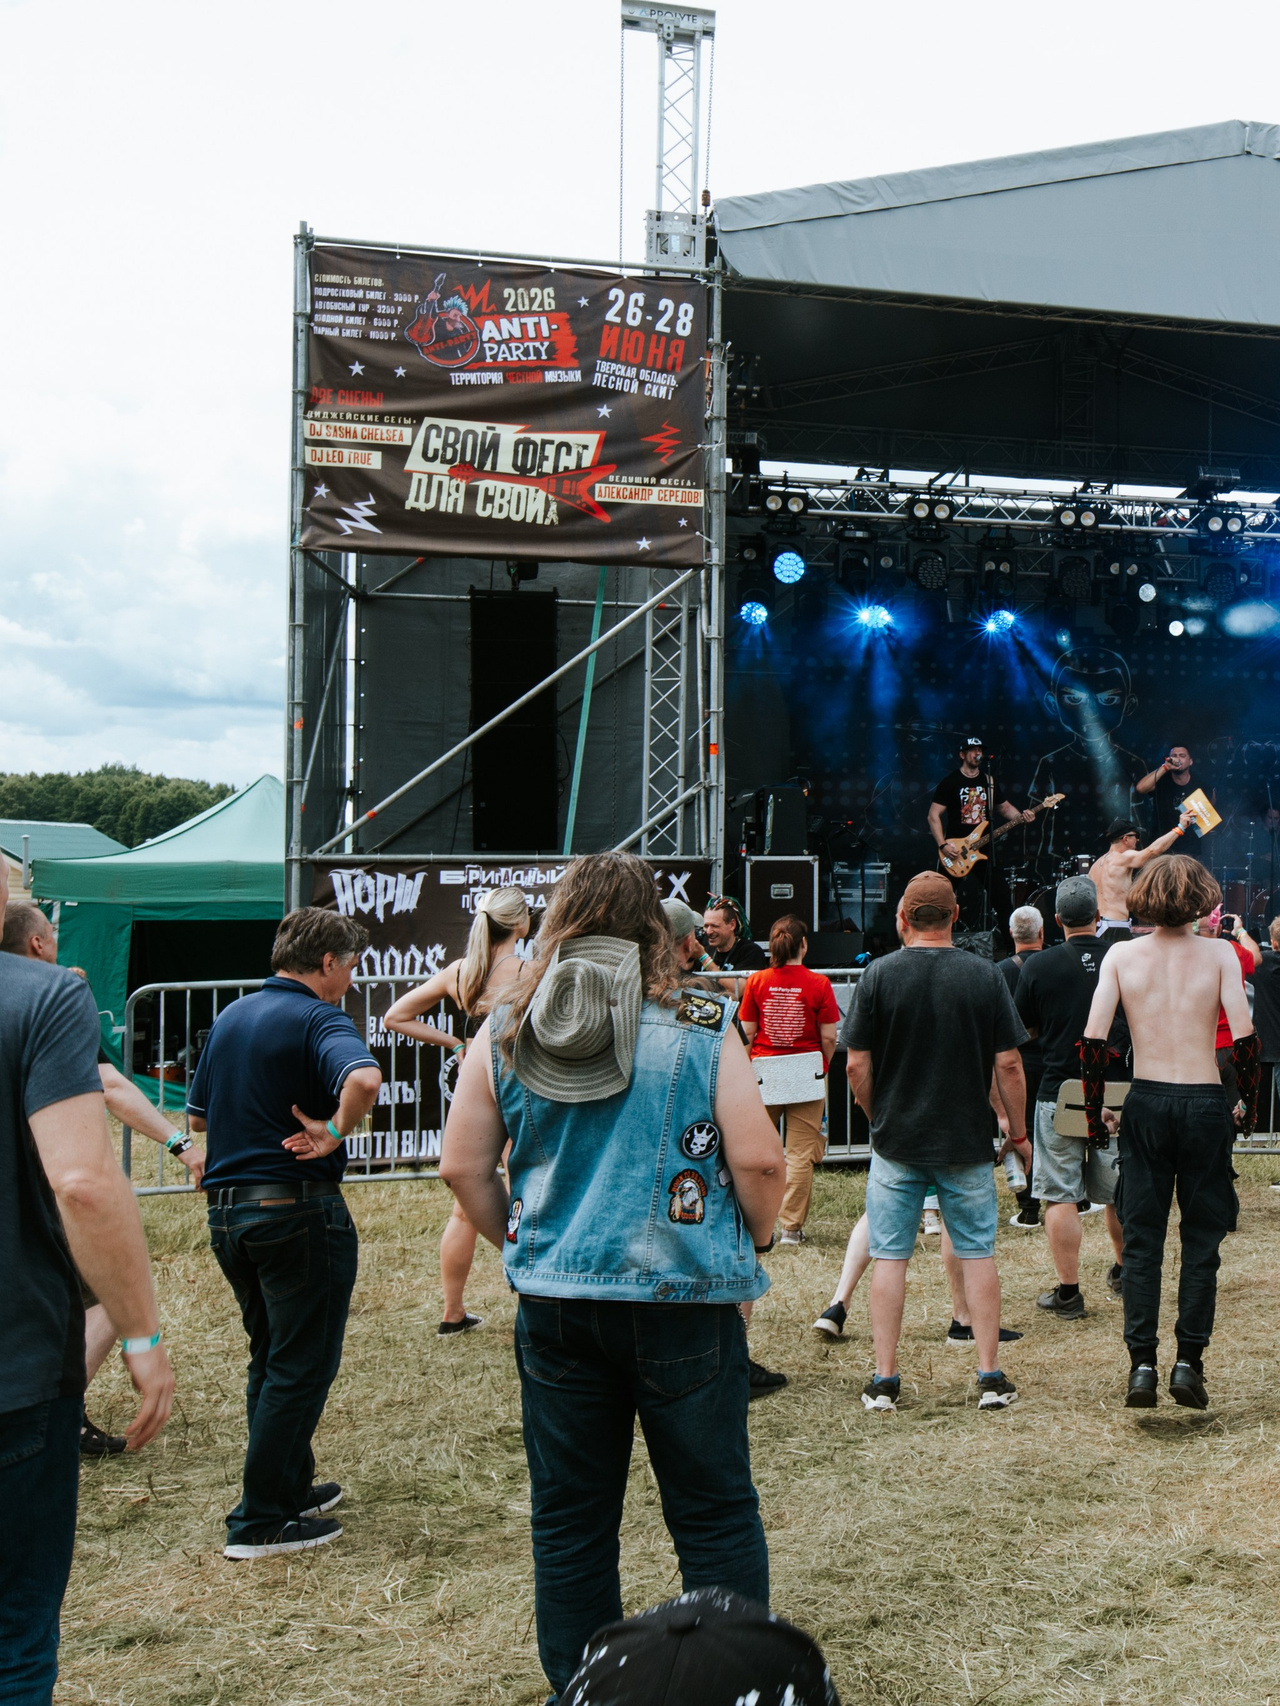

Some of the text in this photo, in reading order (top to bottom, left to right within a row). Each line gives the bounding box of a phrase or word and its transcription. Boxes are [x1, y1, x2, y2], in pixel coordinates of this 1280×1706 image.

[314, 273, 351, 285] СТОИМОСТЬ
[314, 287, 363, 299] ПОДРОСТКОВЫЙ
[365, 290, 387, 300] БИЛЕТ
[503, 287, 555, 312] 2026
[314, 301, 356, 311] АВТОБУСНЫЙ
[605, 287, 694, 337] 26-28
[345, 316, 366, 325] БИЛЕТ
[481, 316, 559, 342] ANTI-
[313, 326, 339, 337] ПАРНЫЙ
[341, 328, 362, 338] БИЛЕТ
[484, 341, 549, 362] PARTY
[599, 324, 685, 373] ИЮНЯ
[450, 370, 582, 385] ТЕРРИТОРИЯ ЧЕСТНОЙ МУЗЫКИ
[596, 360, 637, 379] ТВЕРСКАЯ
[310, 386, 333, 405] ДВЕ
[592, 373, 675, 400] ЛЕСНОЙ СКИТ
[306, 410, 380, 423] ДИДЖЕЙСКИЕ
[309, 423, 404, 442] DJ SASHA CHELSEA
[310, 449, 373, 466] DJ LEO TRUE
[421, 424, 589, 476] СВОЙ ФЕСТ
[608, 475, 657, 486] ВЕДУЩИЙ
[405, 472, 466, 514] ДЛЯ
[597, 485, 653, 502] АЛЕКСАНДР
